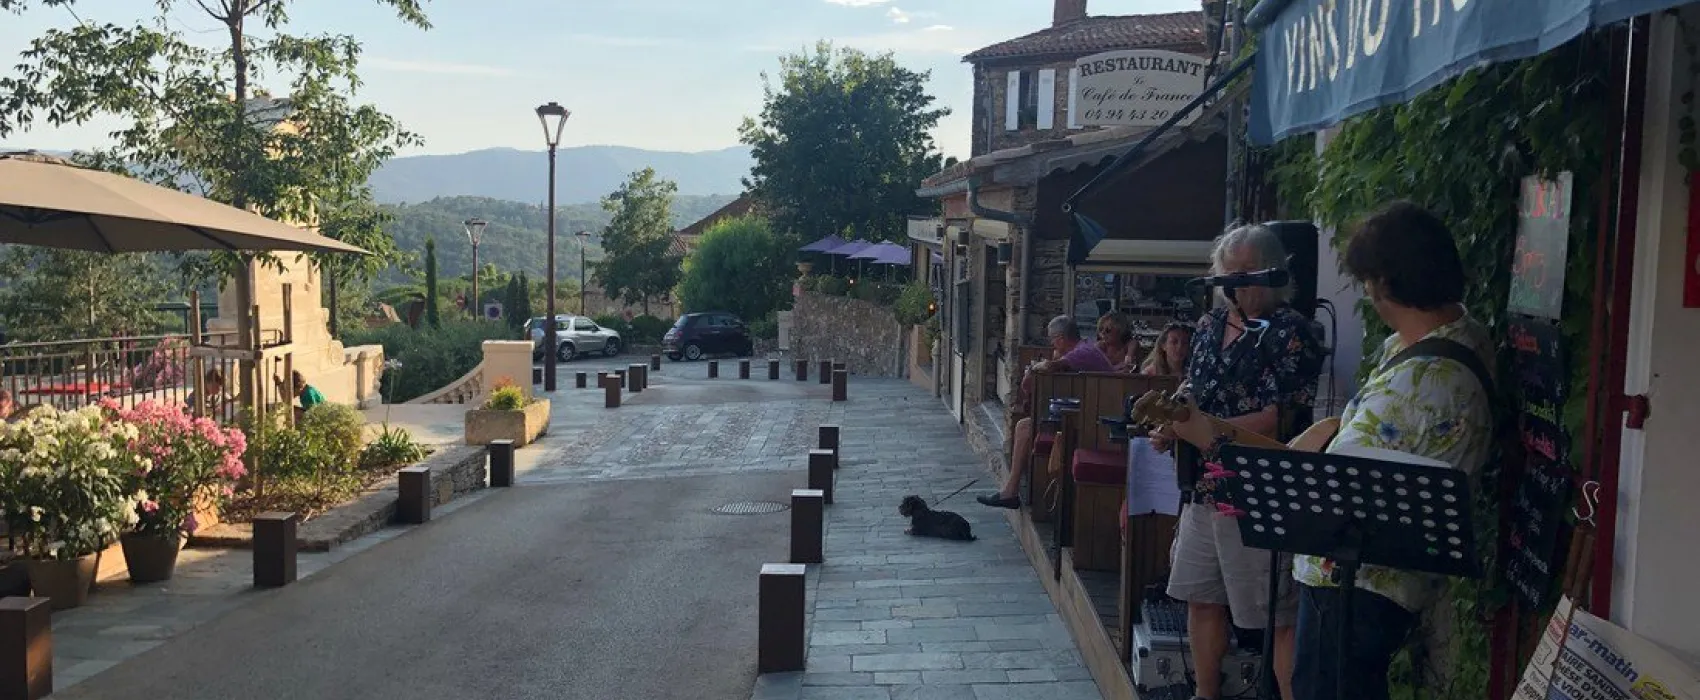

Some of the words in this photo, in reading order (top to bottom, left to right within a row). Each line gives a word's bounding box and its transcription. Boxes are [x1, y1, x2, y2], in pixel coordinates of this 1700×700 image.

[1285, 0, 1340, 95] VINS
[1079, 57, 1203, 77] RESTAURANT
[1081, 86, 1116, 105] Café
[1118, 88, 1134, 102] de
[1141, 87, 1194, 102] France
[1084, 109, 1102, 120] 04
[1105, 109, 1123, 120] 94
[1129, 109, 1147, 120] 43
[1150, 109, 1169, 120] 20
[1570, 624, 1639, 682] ar-matin
